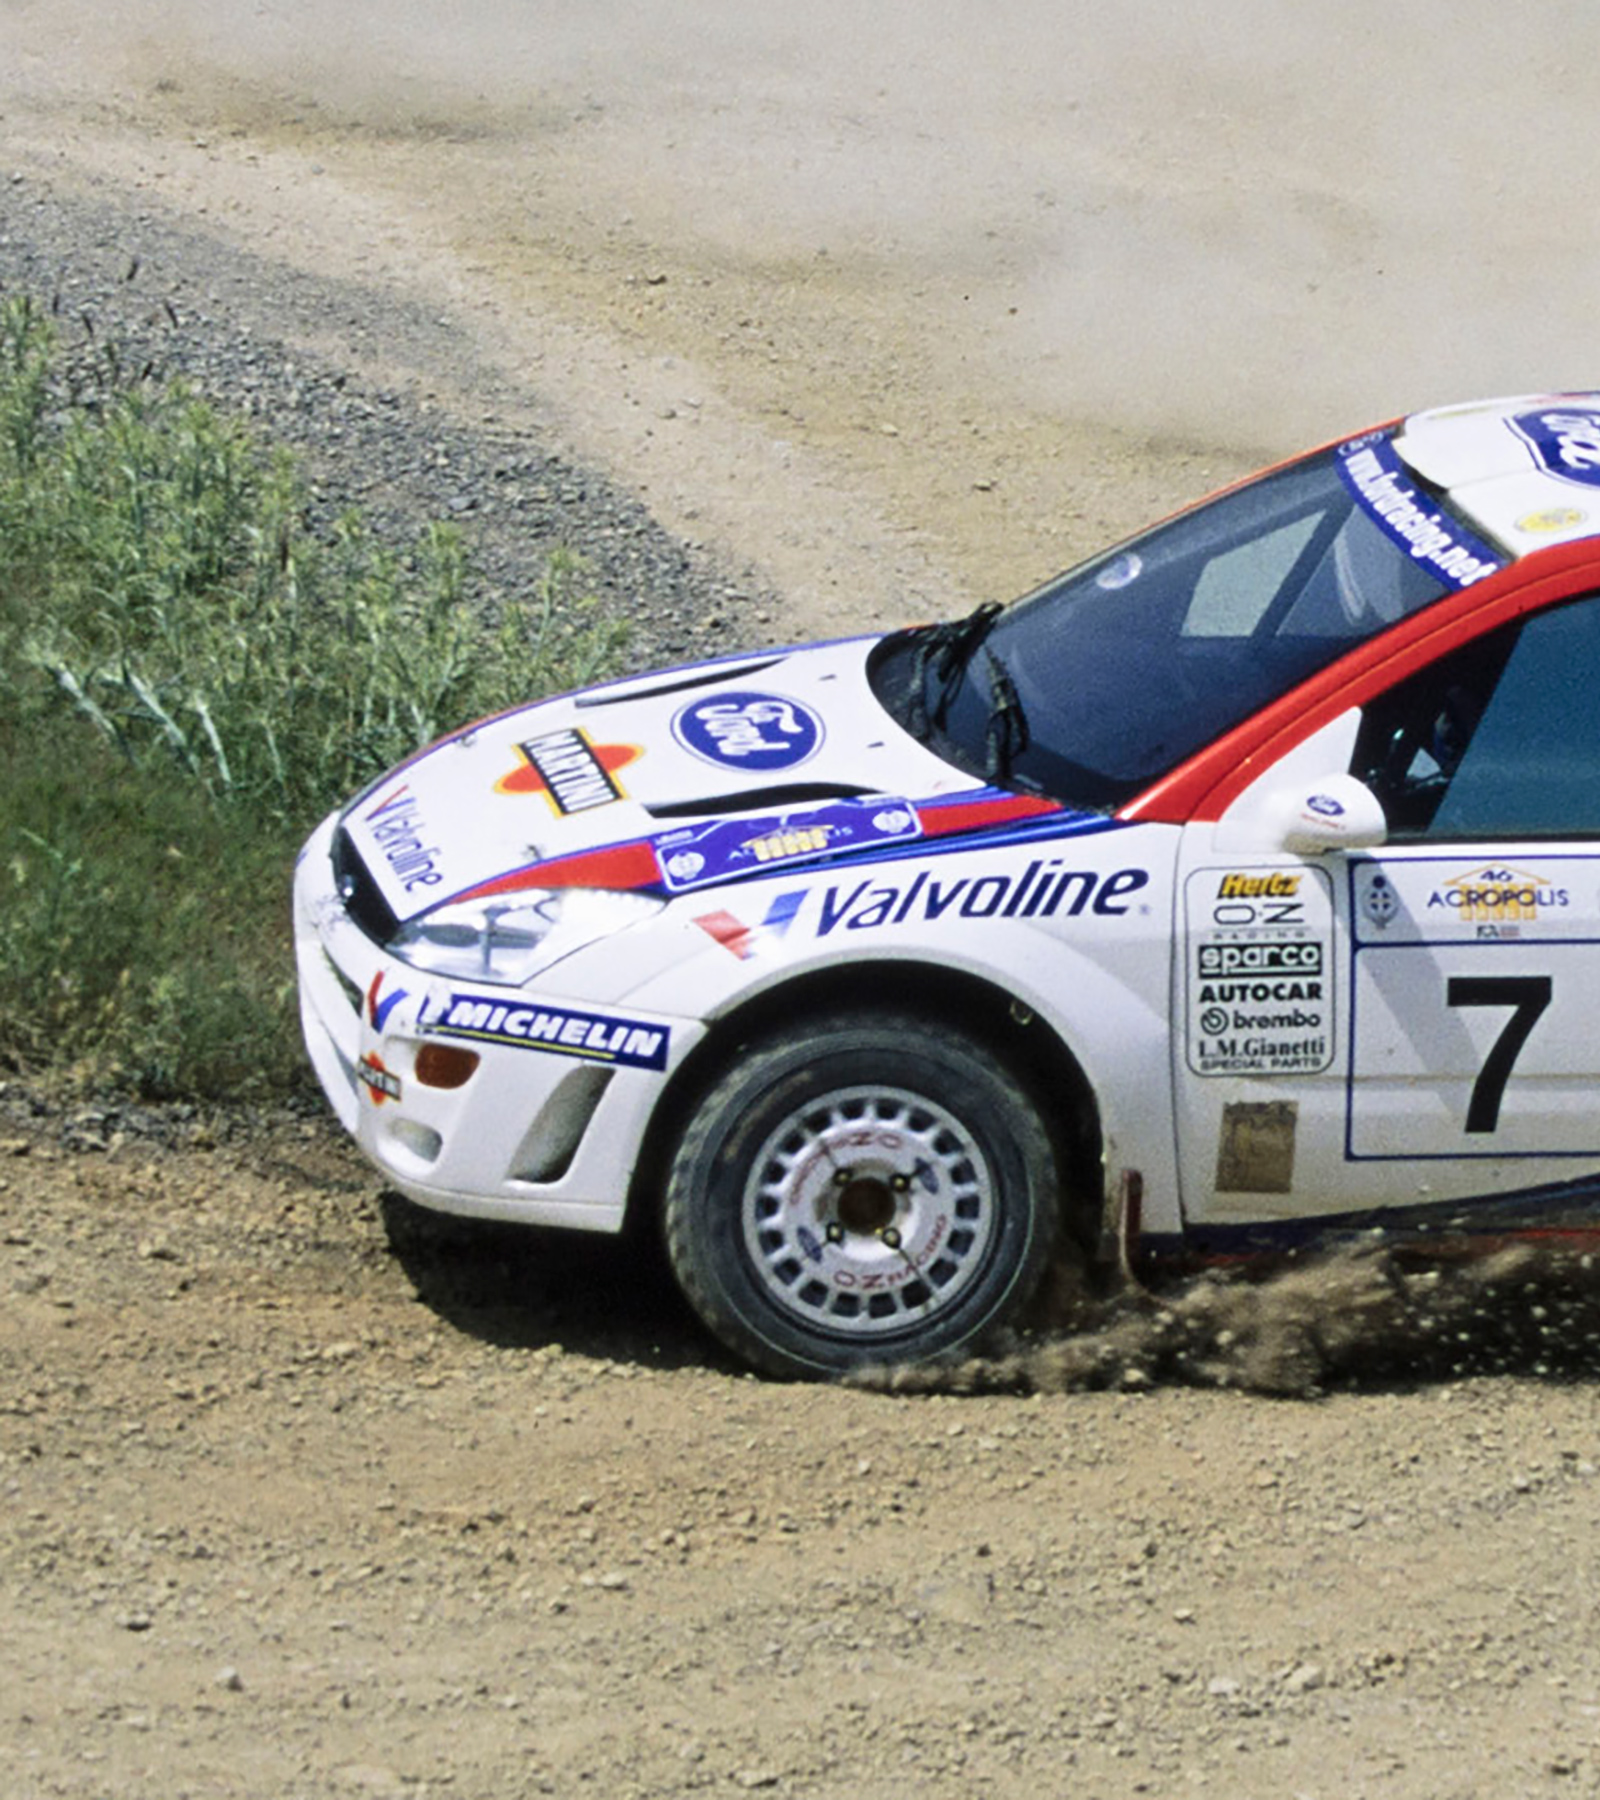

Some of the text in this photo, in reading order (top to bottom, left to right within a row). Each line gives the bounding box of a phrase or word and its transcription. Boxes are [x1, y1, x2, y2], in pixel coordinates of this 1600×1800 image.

[520, 730, 614, 812] MARTINI
[816, 859, 1150, 937] Valvoline
[1217, 873, 1303, 899] Hertz
[1427, 888, 1570, 908] ACROPOLIS
[1202, 945, 1320, 975] sparco
[1200, 983, 1322, 1002] AUTOCAR
[446, 1000, 664, 1057] MICHELIN
[1233, 1008, 1321, 1029] brembo
[1270, 1057, 1322, 1068] PARTS
[1447, 976, 1553, 1133] 7
